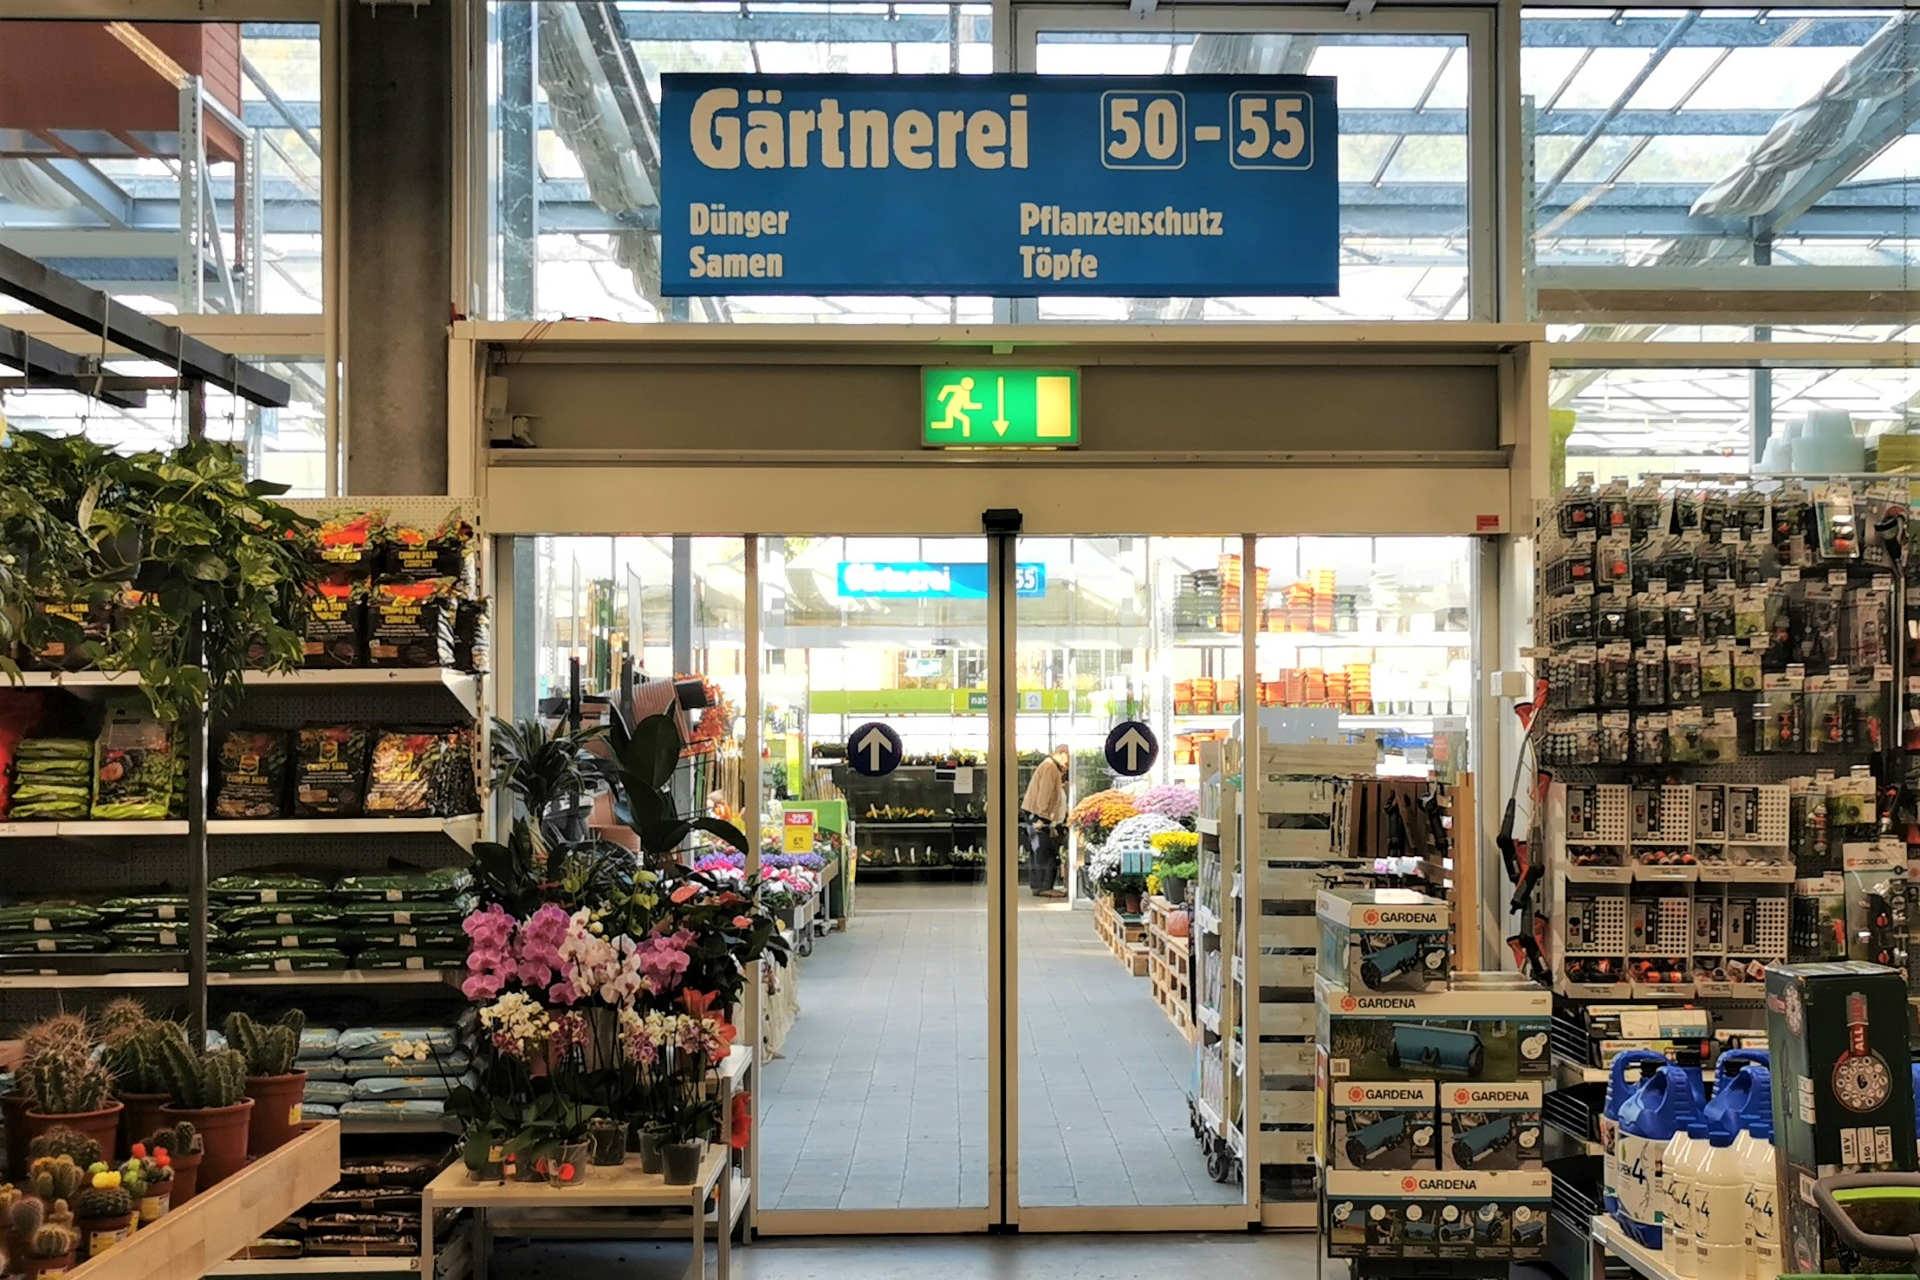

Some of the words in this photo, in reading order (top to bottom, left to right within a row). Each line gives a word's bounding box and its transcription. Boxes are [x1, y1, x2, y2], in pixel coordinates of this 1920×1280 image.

[690, 88, 1029, 170] Gärtnerei
[1107, 98, 1178, 160] 50
[1236, 98, 1305, 160] 55
[689, 202, 790, 238] Dünger
[1020, 202, 1223, 236] Pflanzenschutz
[689, 245, 783, 278] Samen
[1019, 245, 1098, 281] Töpfe
[1380, 912, 1438, 924] GARDENA
[1358, 998, 1416, 1009] GARDENA
[1854, 1026, 1865, 1051] ALL
[1366, 1089, 1424, 1101] GARDENA
[1471, 1091, 1529, 1102] GARDENA
[1631, 1157, 1647, 1185] 4
[1418, 1179, 1477, 1190] GARDENA
[1681, 1191, 1691, 1209] 4
[1700, 1200, 1710, 1217] 4
[1744, 1191, 1755, 1208] 4
[1763, 1200, 1774, 1218] 4
